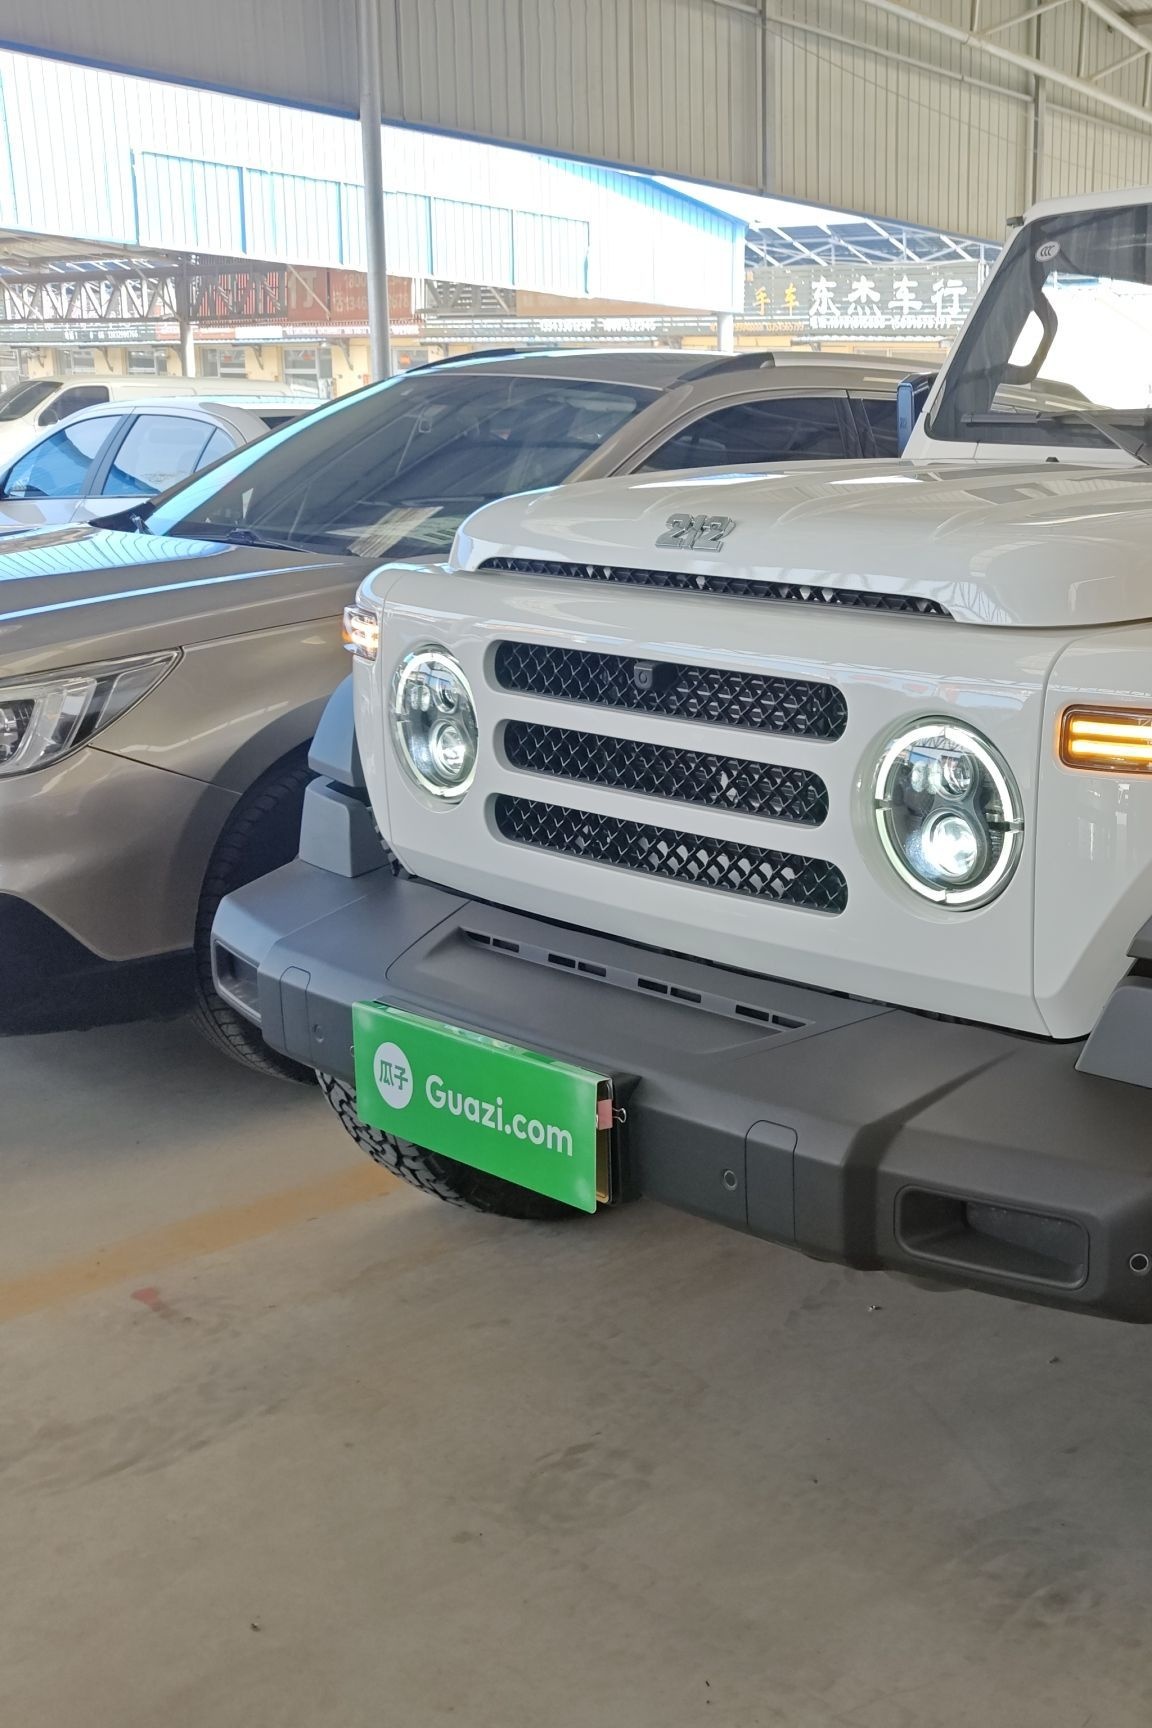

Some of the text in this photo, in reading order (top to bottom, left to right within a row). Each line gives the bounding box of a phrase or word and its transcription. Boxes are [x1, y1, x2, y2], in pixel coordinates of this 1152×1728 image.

[809, 274, 968, 319] 东杰车行
[655, 513, 737, 553] 212
[378, 1059, 409, 1091] 瓜子
[425, 1074, 574, 1157] Guazi.com
